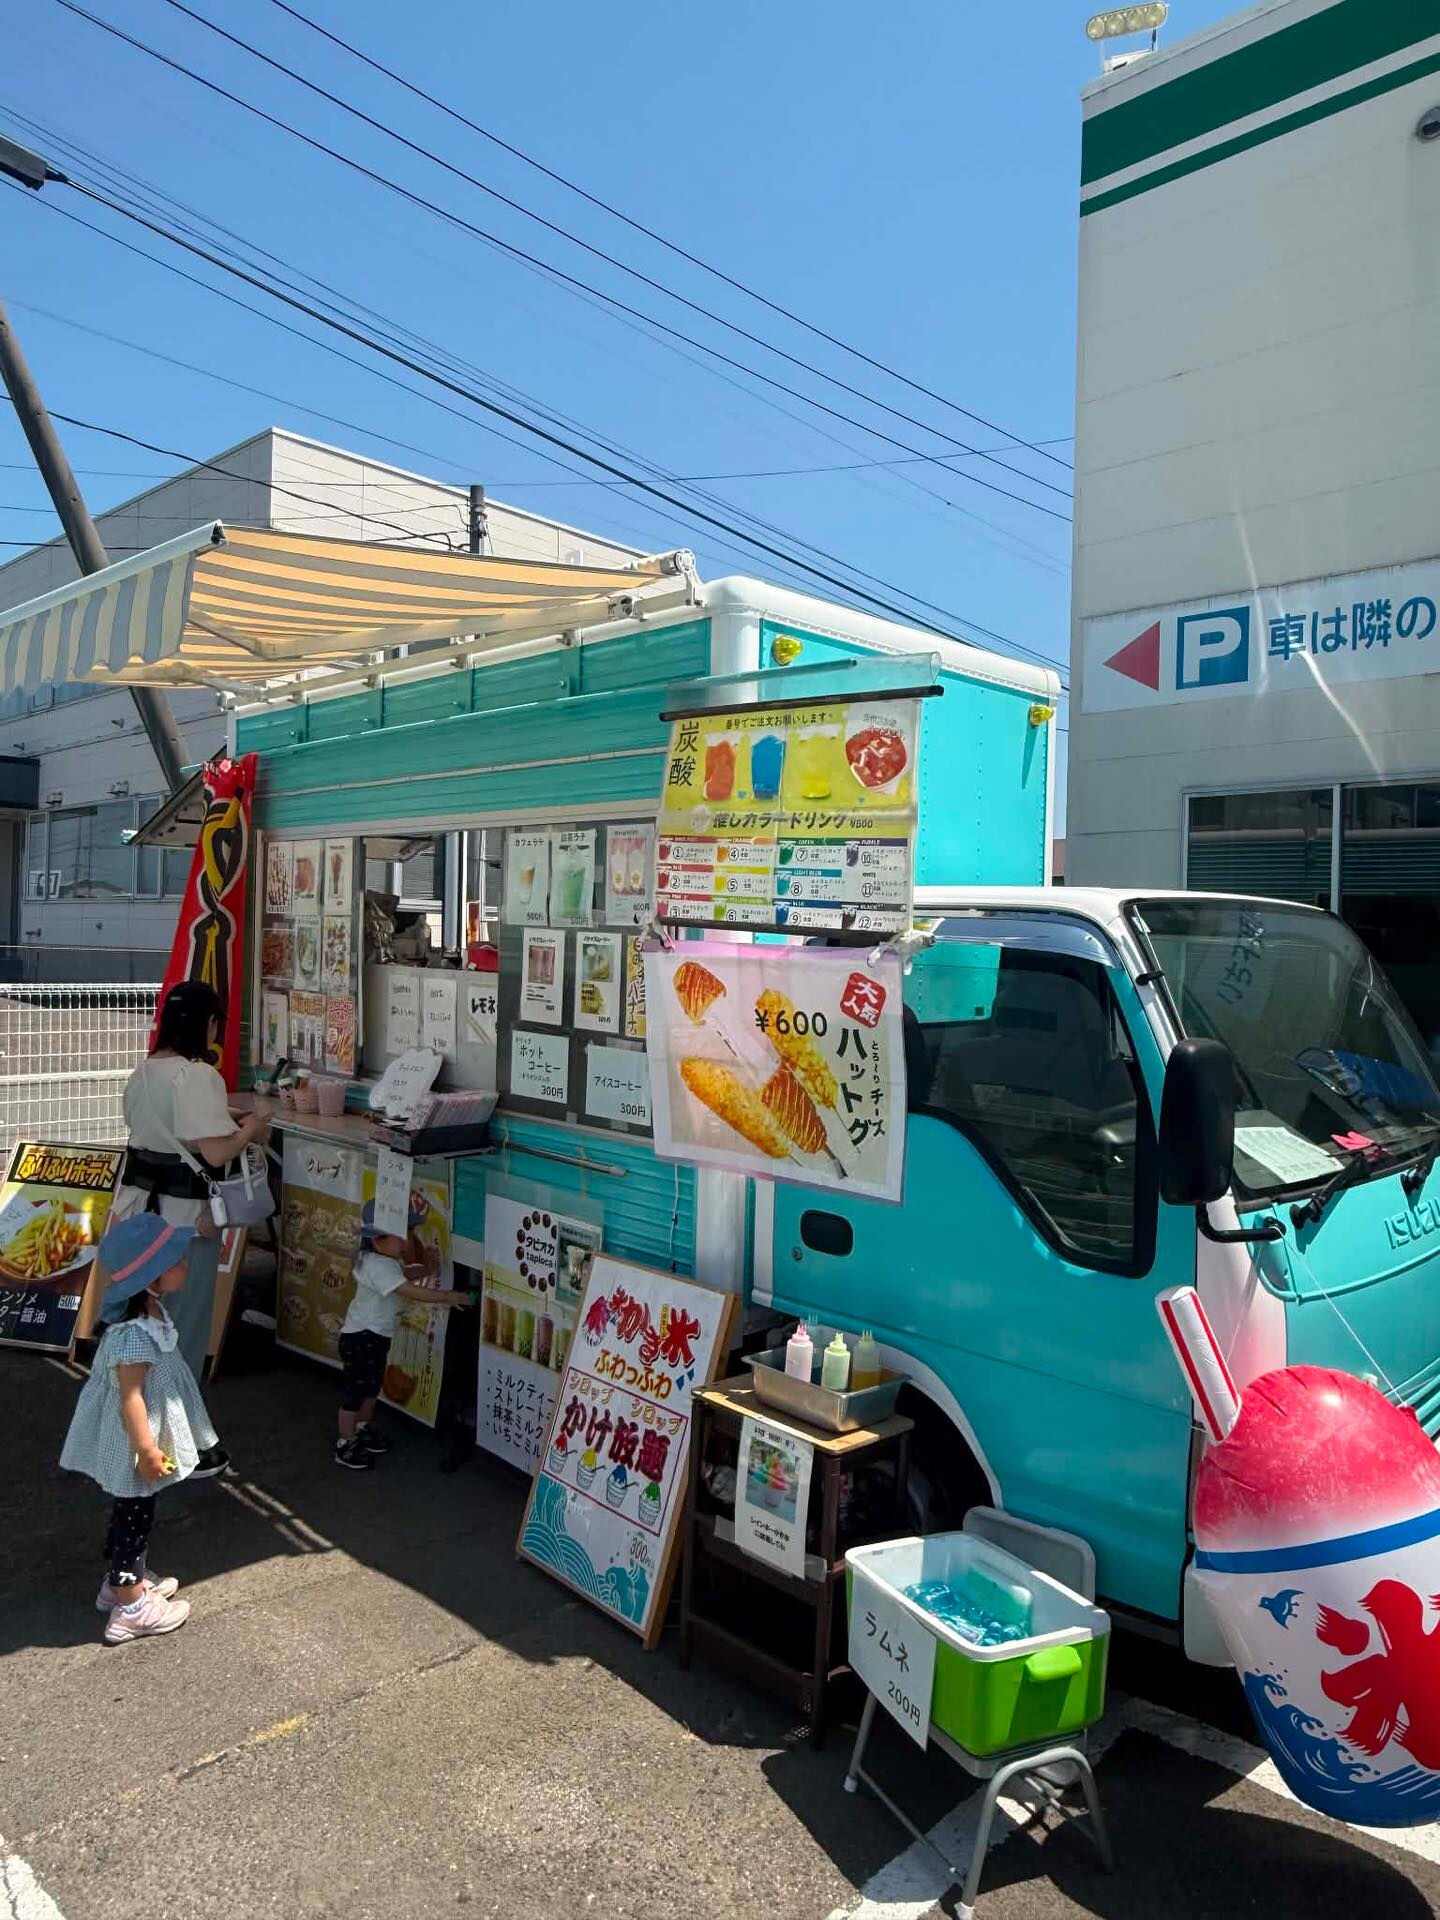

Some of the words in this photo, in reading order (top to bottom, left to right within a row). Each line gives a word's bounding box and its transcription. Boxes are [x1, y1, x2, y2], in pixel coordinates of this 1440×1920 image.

[1267, 596, 1437, 661] 車は隣の
[668, 720, 700, 787] 炭酸
[755, 1009, 828, 1038] ¥600
[519, 1045, 544, 1060] ホット
[527, 1061, 561, 1073] コーヒー
[541, 1085, 564, 1099] 300円
[593, 1075, 642, 1091] アイスコーヒー
[836, 1027, 873, 1147] ハットグ
[619, 1103, 646, 1117] 300円
[525, 1236, 556, 1257] タピオカ
[526, 1251, 553, 1268] tapioca
[560, 1395, 671, 1483] かけ放題
[865, 1612, 910, 1673] ラムネ
[887, 1680, 922, 1728] 200円
